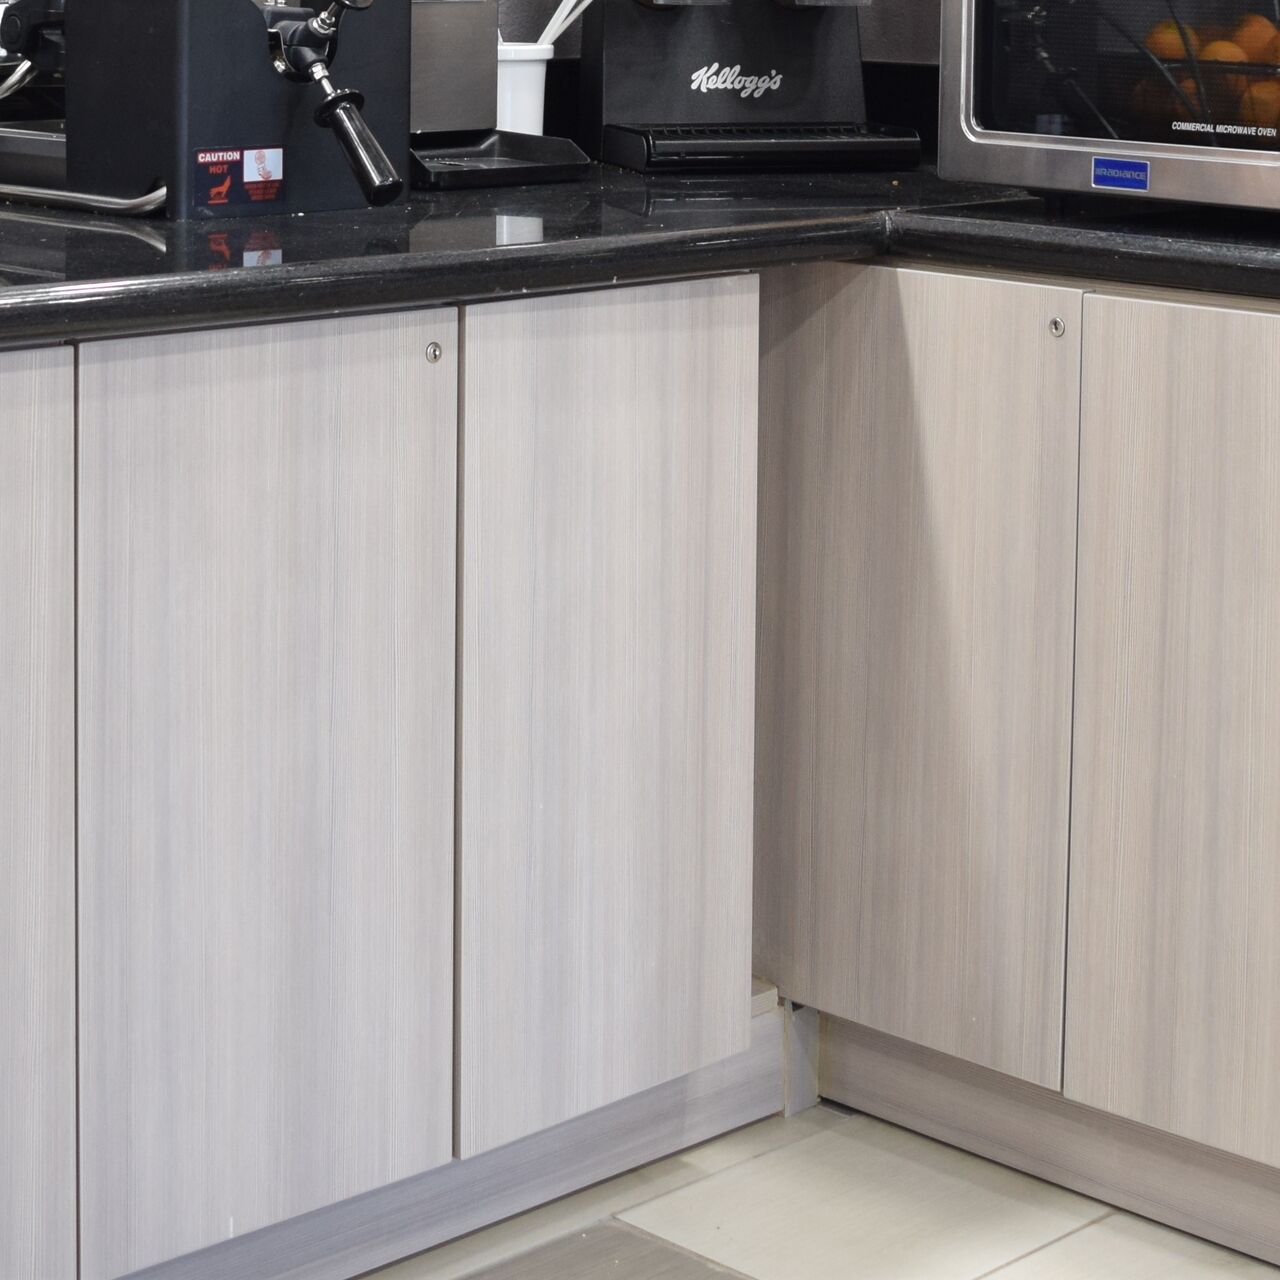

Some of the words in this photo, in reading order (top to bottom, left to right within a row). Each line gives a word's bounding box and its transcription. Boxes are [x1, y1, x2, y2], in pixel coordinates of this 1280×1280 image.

[690, 62, 784, 98] Kellogg's
[1171, 121, 1215, 133] COMMERCIAL
[1216, 124, 1257, 136] MICROWAVE
[1257, 127, 1277, 137] OVEN
[198, 151, 240, 162] CAUTION
[209, 164, 229, 174] HOT
